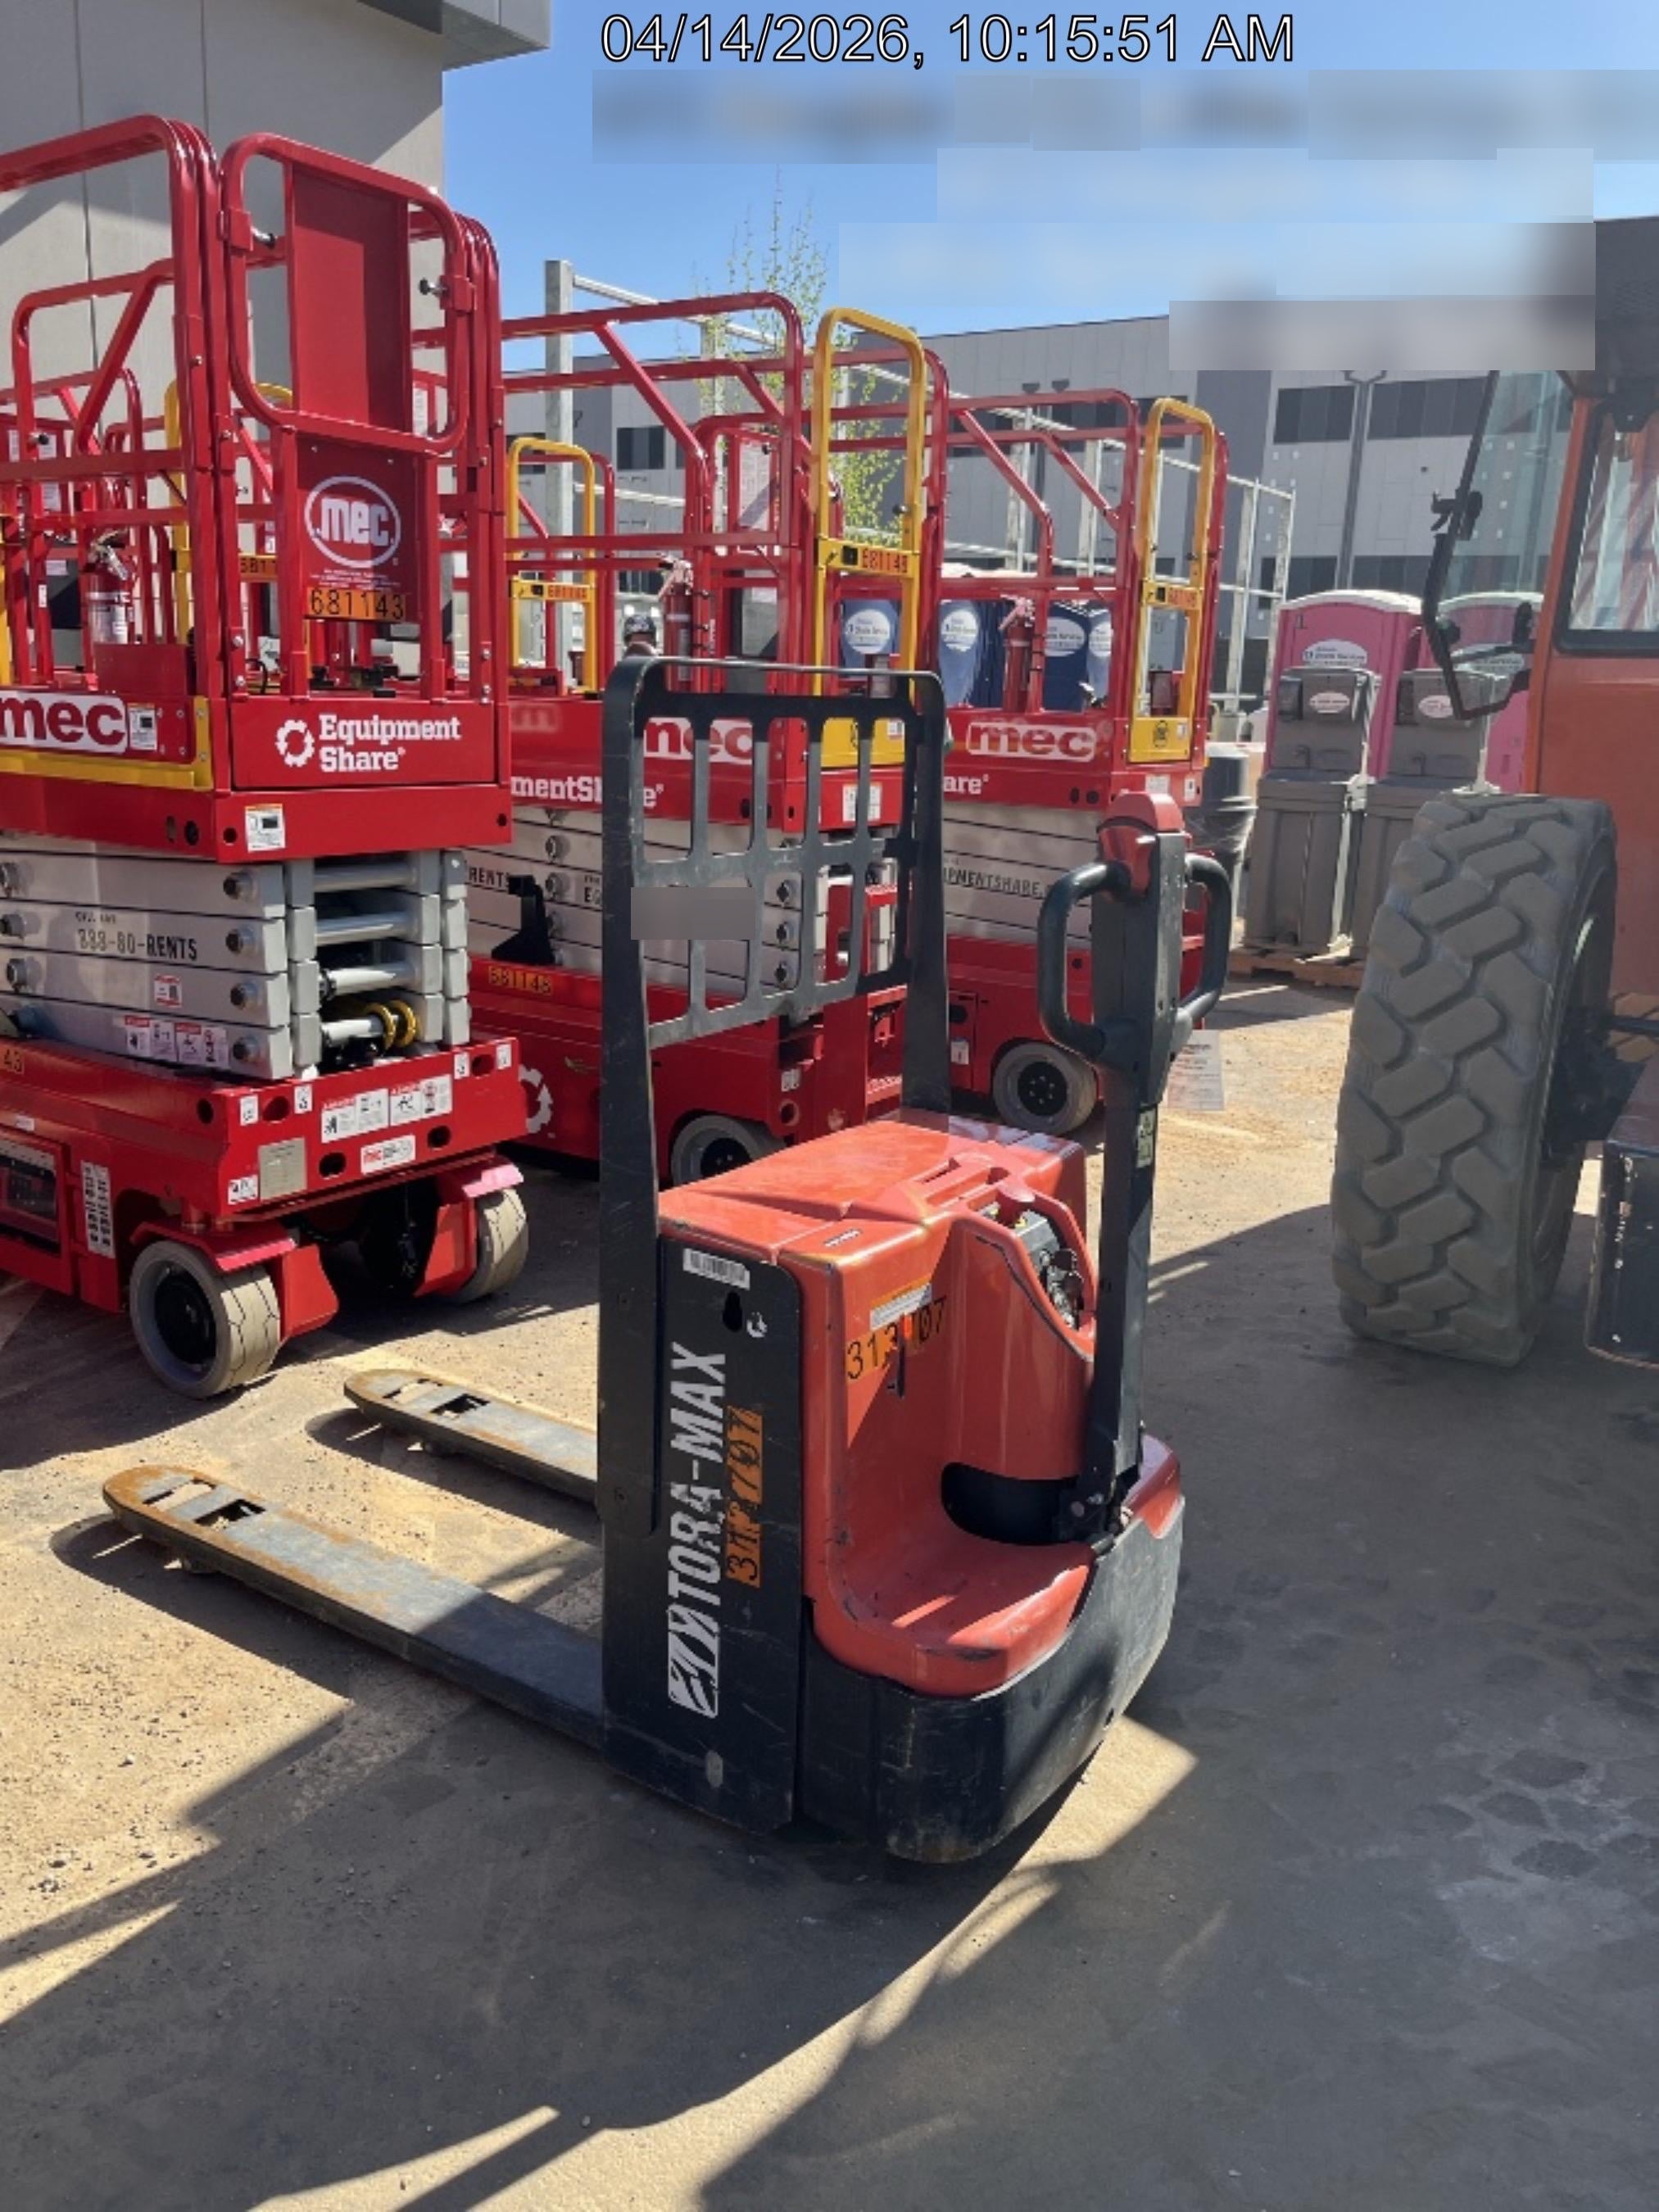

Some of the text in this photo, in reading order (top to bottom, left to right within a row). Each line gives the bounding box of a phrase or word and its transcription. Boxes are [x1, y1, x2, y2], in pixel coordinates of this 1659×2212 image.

[321, 497, 388, 546] mec
[310, 589, 404, 619] 681143
[0, 697, 125, 746] mec
[319, 714, 461, 746] Equipment
[968, 725, 1095, 757] mec
[668, 1340, 725, 1607] TORA-MAX
